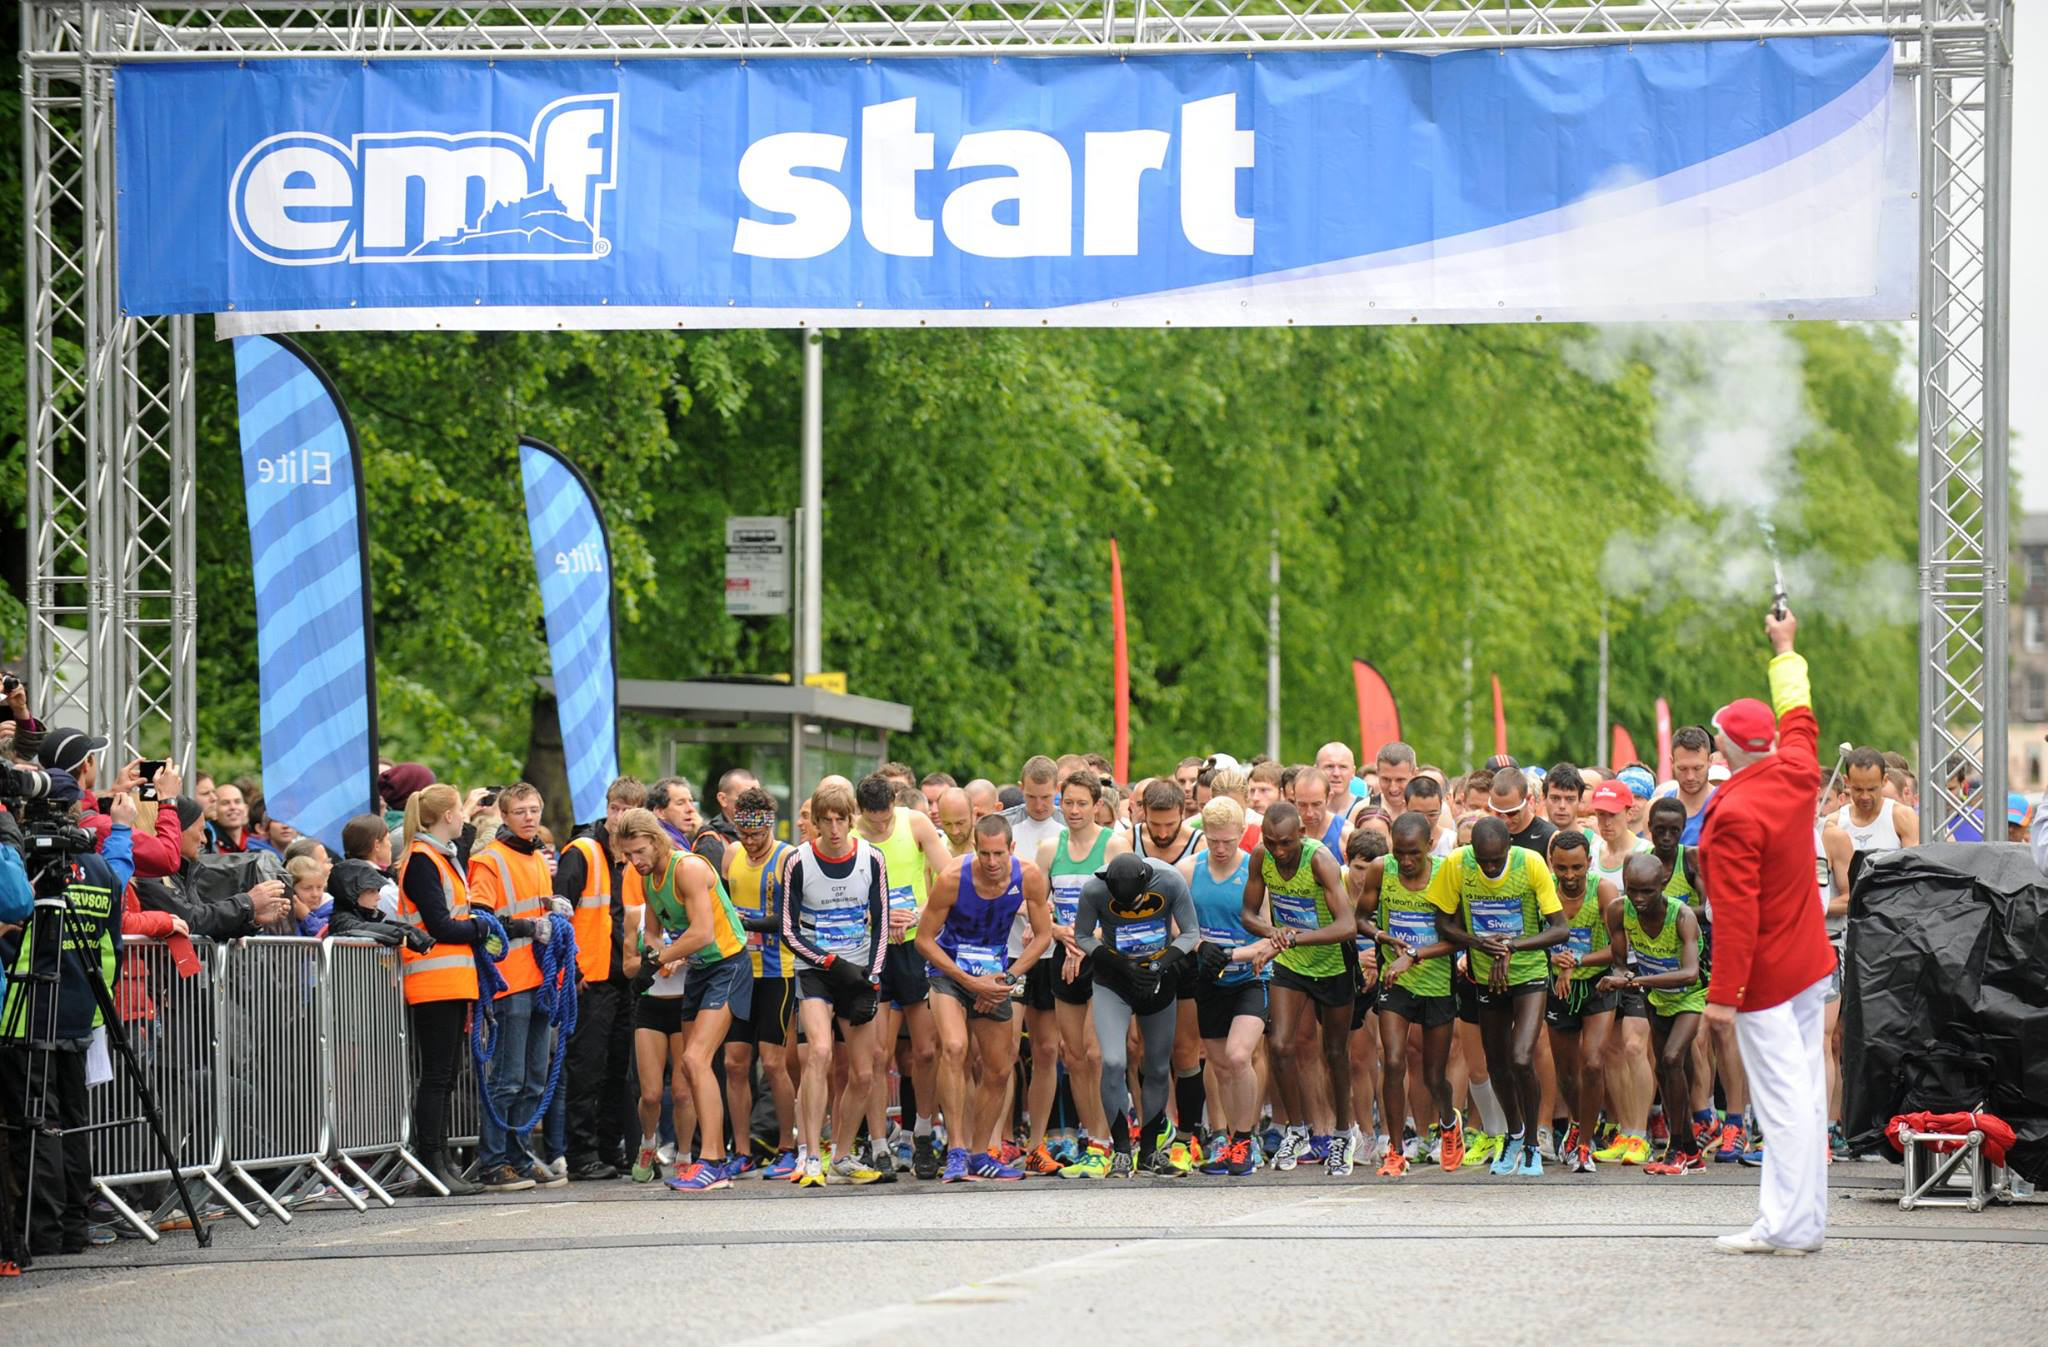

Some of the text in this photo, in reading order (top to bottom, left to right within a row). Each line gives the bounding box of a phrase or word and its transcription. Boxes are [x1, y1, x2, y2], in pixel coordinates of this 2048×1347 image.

[244, 108, 605, 250] emf
[732, 92, 1255, 259] start
[820, 896, 859, 905] EDINBURGH
